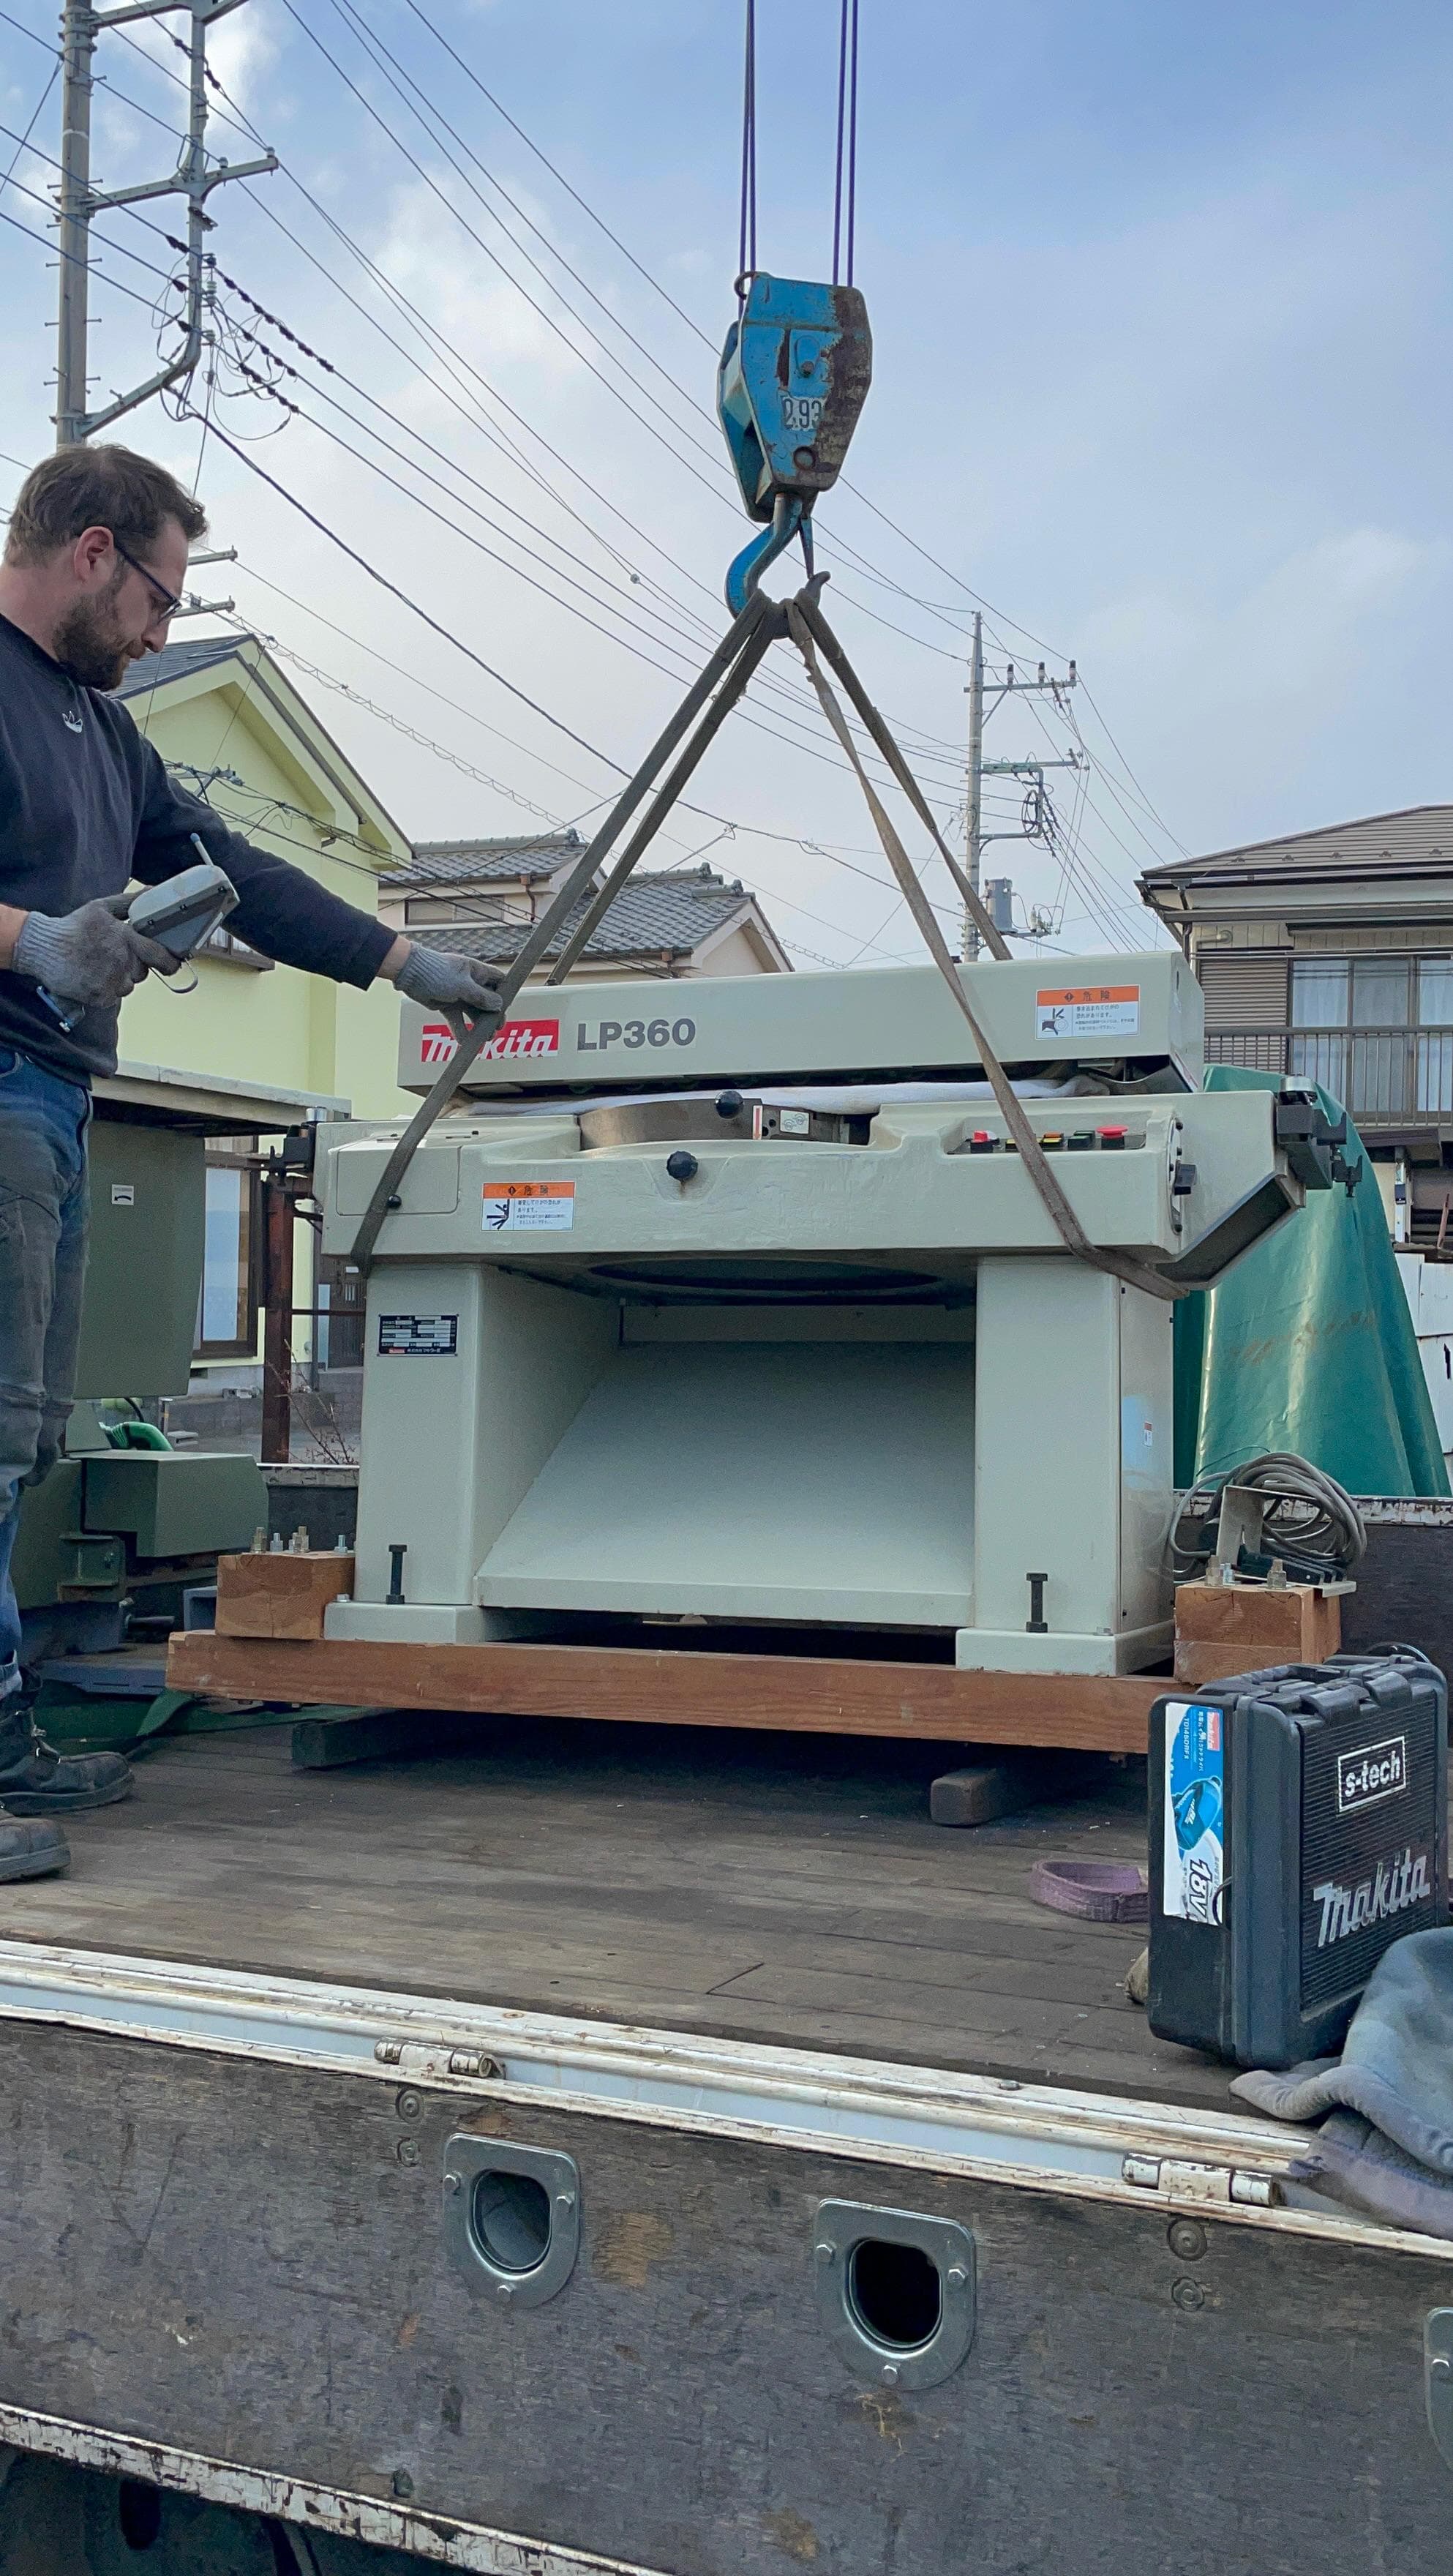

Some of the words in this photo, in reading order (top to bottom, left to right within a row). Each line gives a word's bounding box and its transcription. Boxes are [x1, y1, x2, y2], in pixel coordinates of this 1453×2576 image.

[577, 1018, 696, 1051] LP360
[1345, 1751, 1400, 1797] s-tech
[1189, 1858, 1213, 1919] 18V
